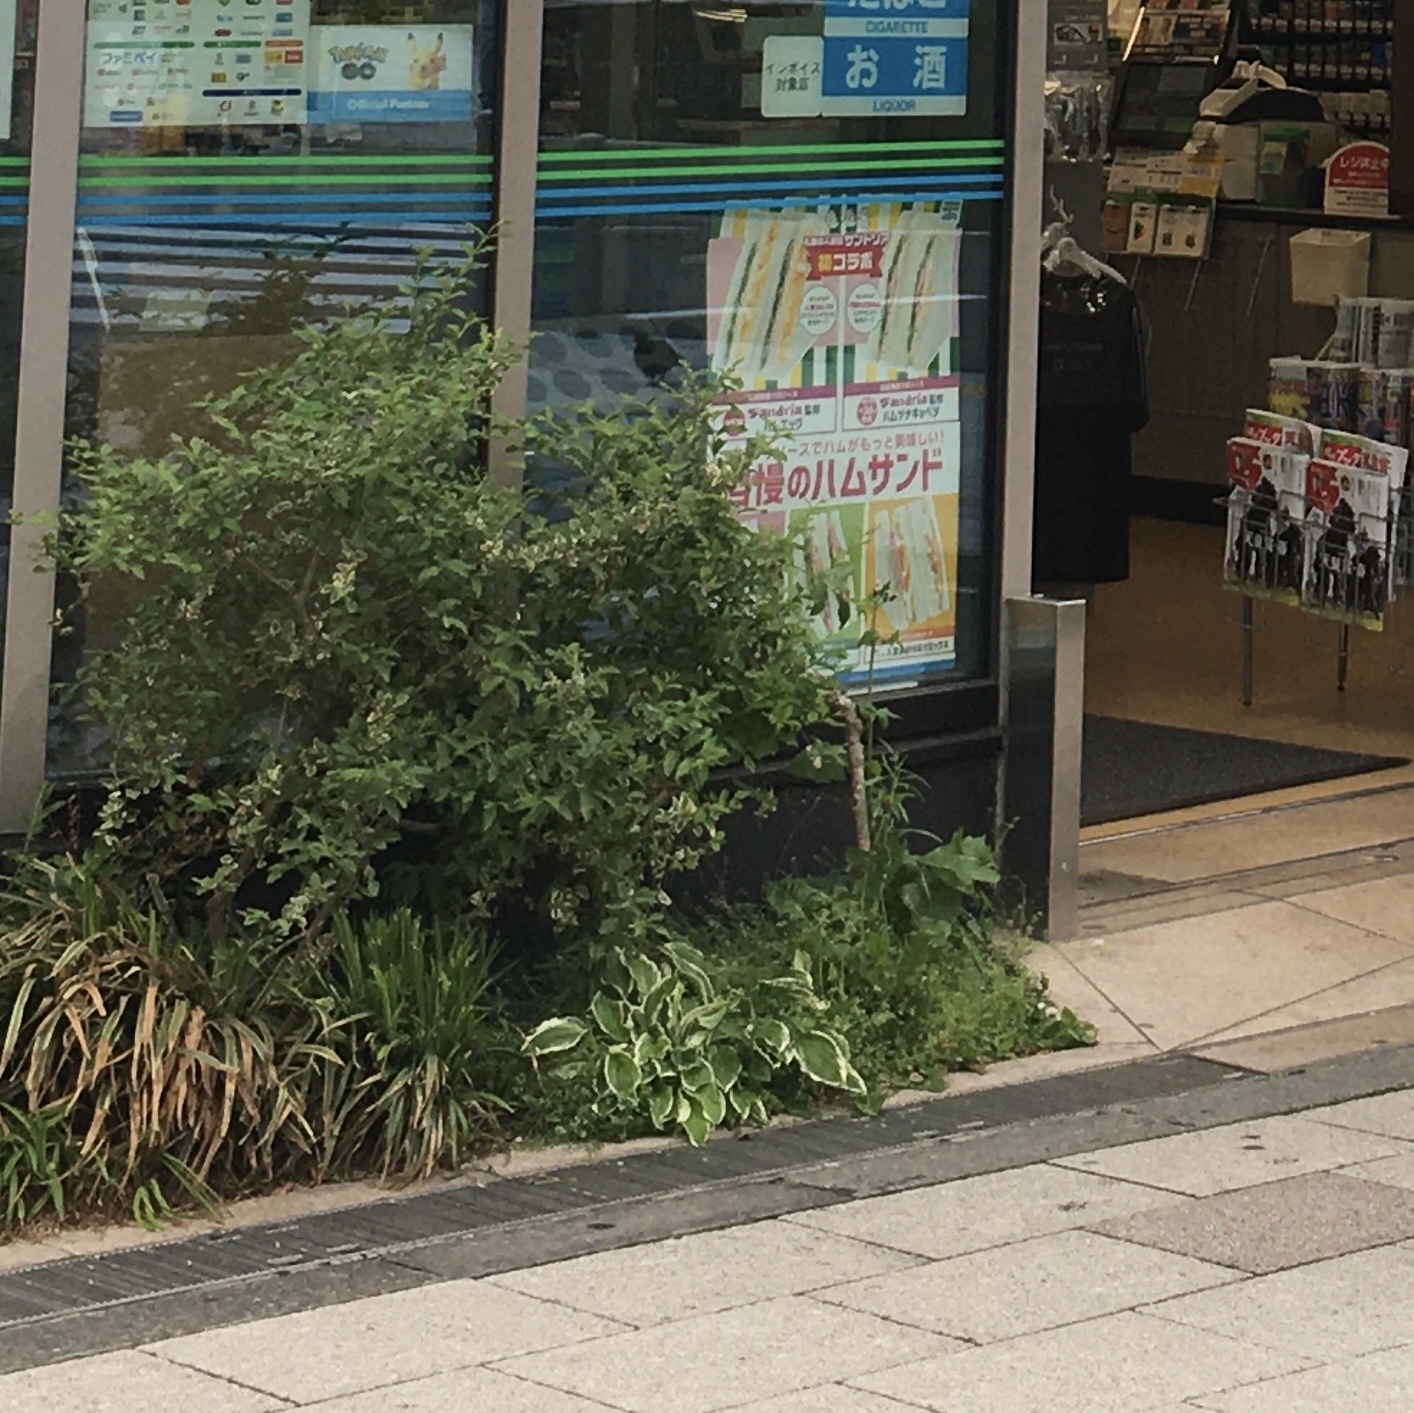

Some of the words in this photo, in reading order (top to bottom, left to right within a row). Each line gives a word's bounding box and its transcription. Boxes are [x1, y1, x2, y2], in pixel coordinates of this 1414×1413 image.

[865, 21, 928, 33] CIGARETTE
[341, 62, 377, 80] GO
[766, 61, 820, 76] インボイス
[873, 100, 916, 112] LIQUOR
